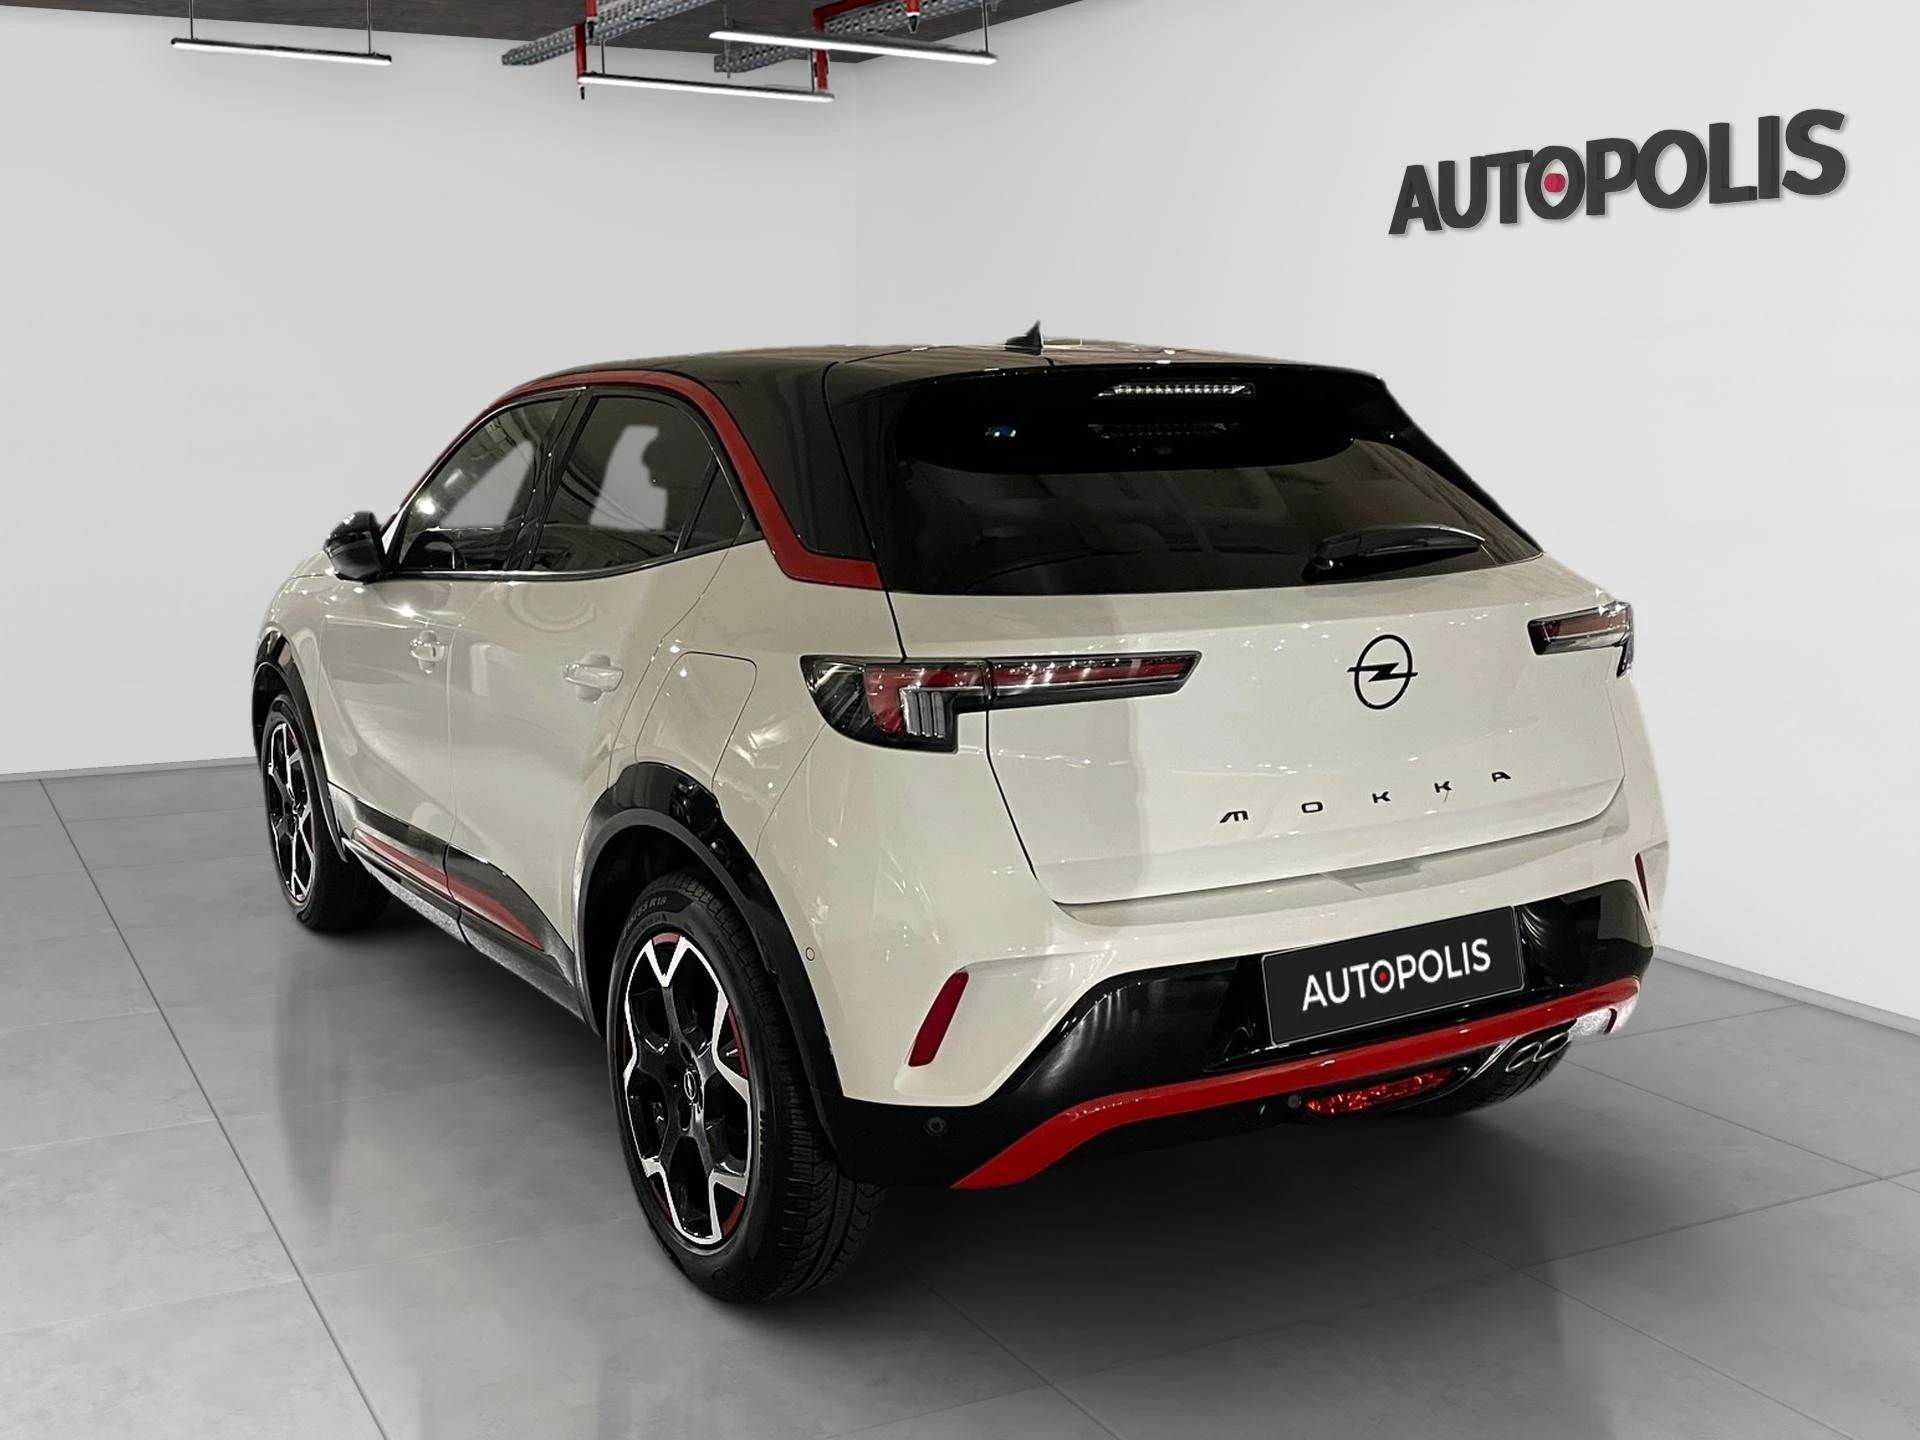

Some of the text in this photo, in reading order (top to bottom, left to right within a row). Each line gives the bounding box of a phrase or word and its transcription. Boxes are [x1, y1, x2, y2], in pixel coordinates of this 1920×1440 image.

[1388, 108, 1847, 235] AUTOPOLIS
[1219, 771, 1512, 823] MOKKA
[1302, 938, 1491, 1011] AUTOPOLIS
